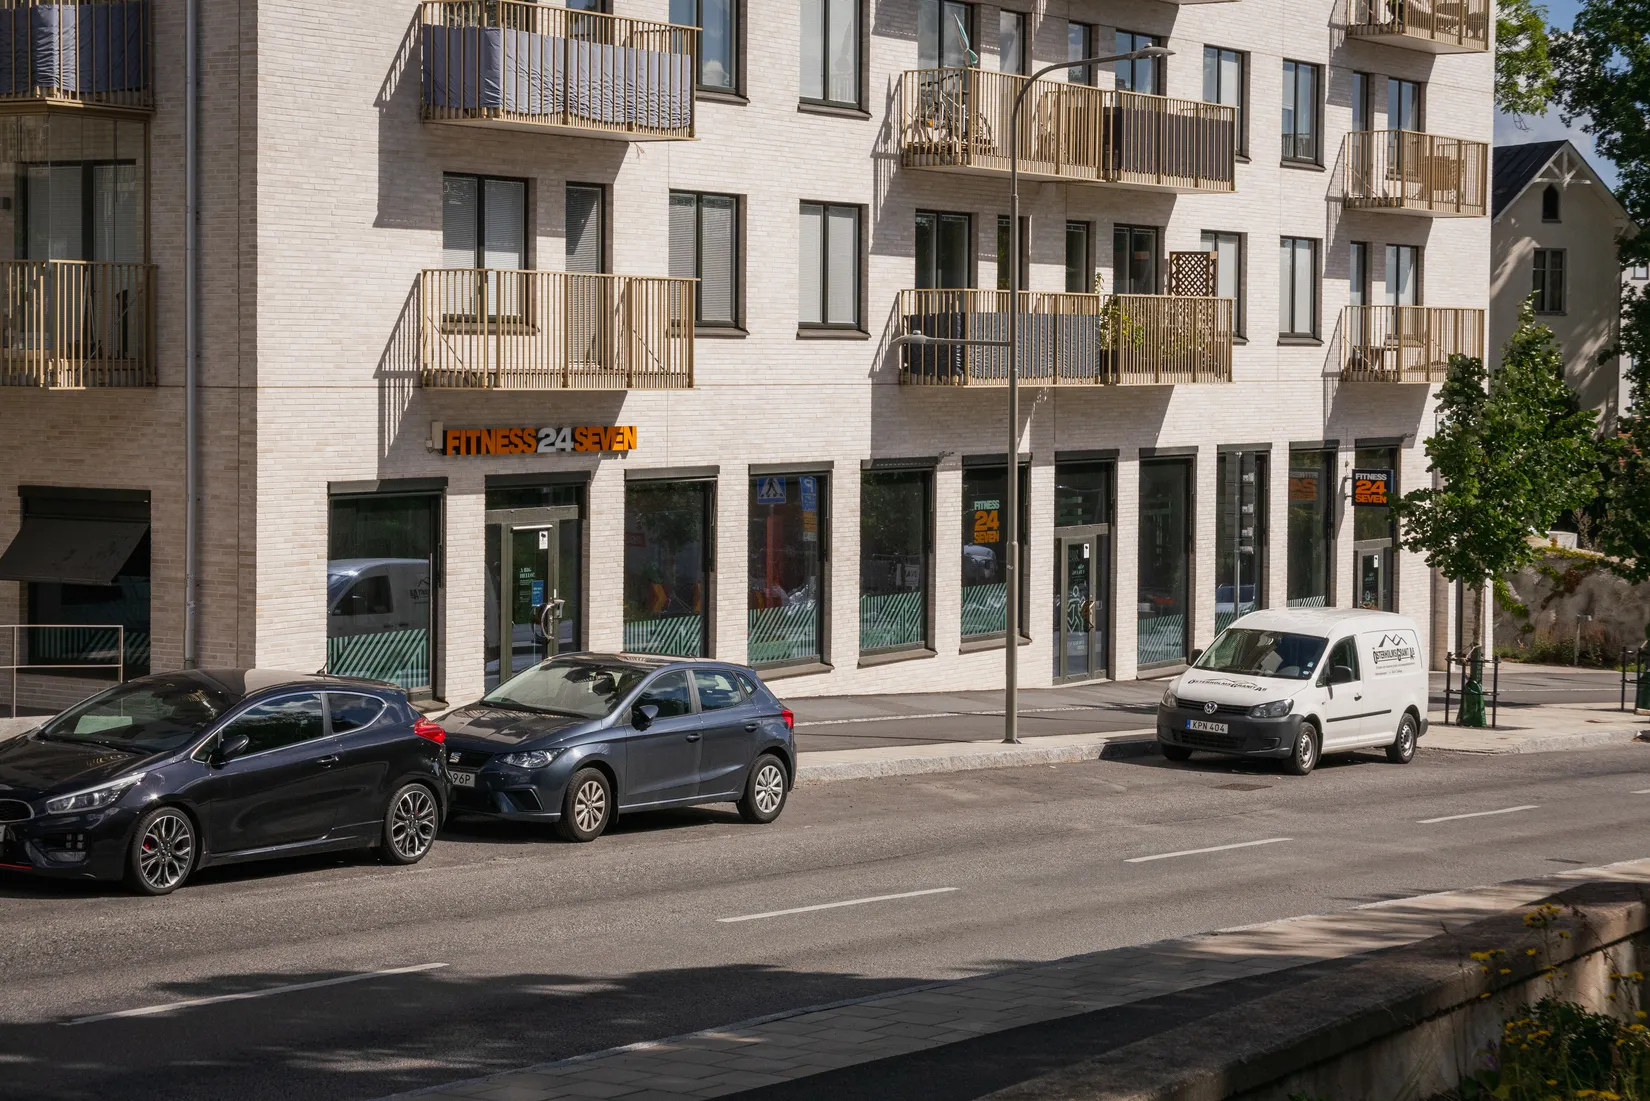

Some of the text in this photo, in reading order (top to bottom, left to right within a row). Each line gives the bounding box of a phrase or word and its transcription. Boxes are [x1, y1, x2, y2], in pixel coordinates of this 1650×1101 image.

[1356, 480, 1386, 494] 24
[1355, 494, 1387, 504] SEVEN
[974, 500, 1000, 510] FITNESS
[975, 510, 1000, 531] 24
[974, 531, 999, 544] SEVEN
[1192, 722, 1225, 732] KPN 404
[453, 773, 471, 784] 96P
